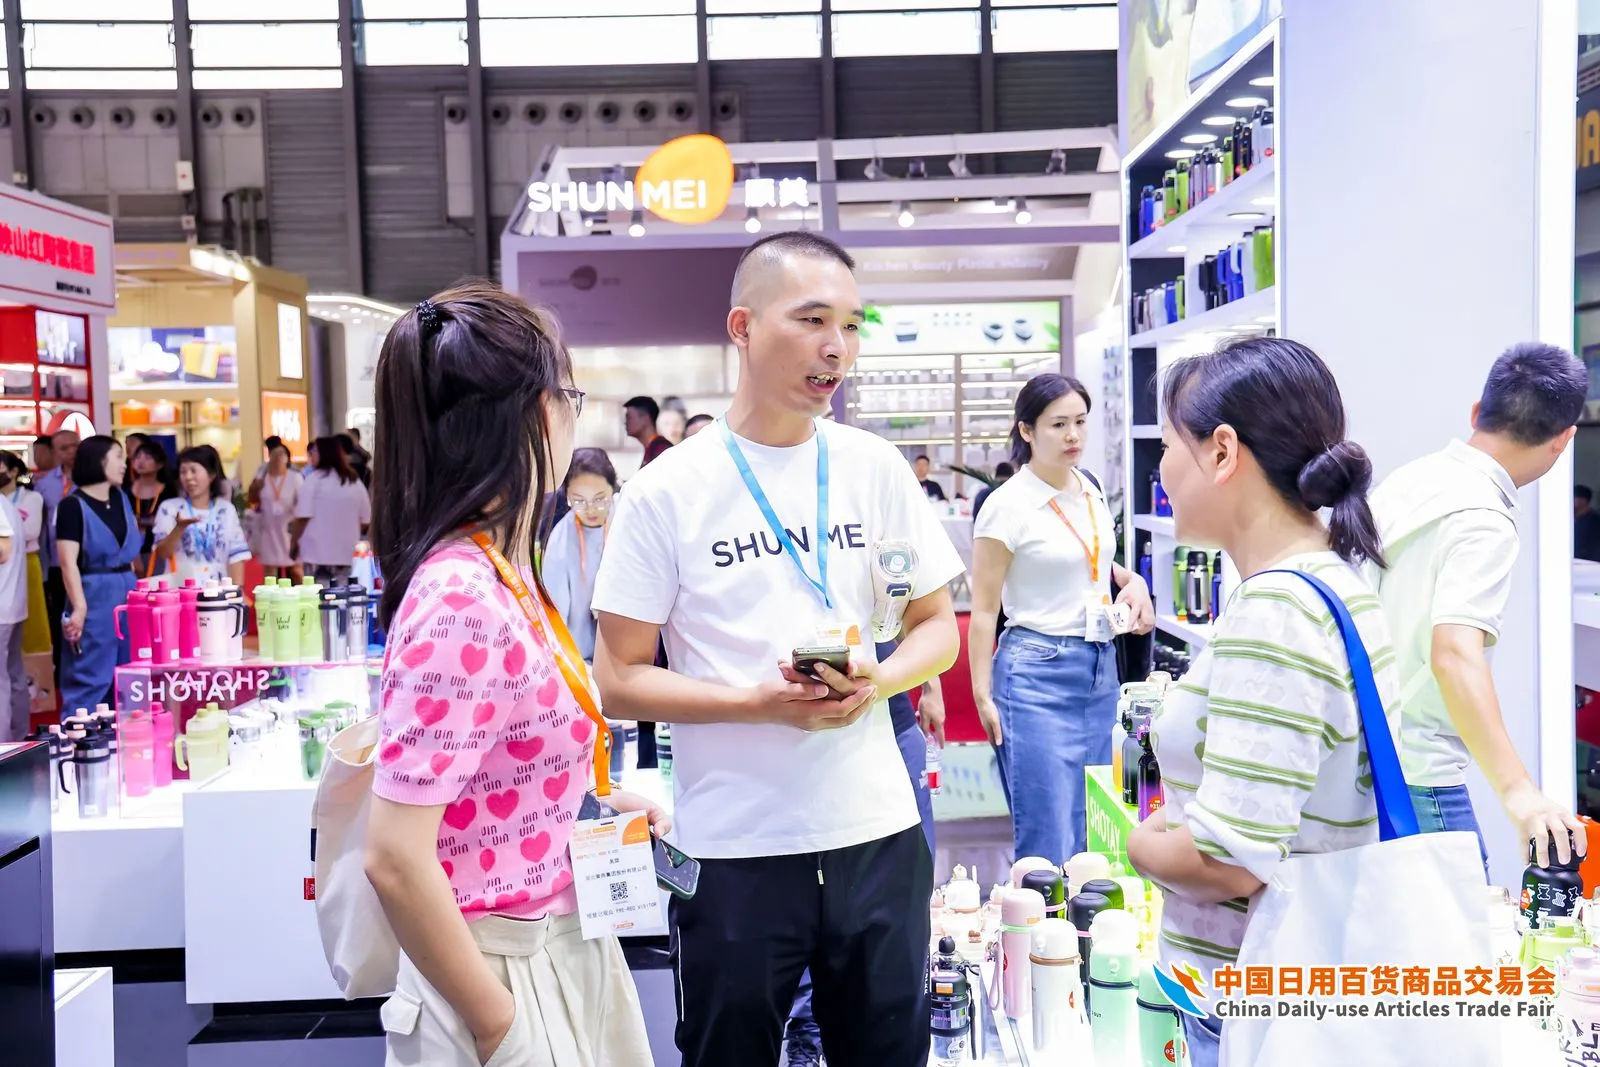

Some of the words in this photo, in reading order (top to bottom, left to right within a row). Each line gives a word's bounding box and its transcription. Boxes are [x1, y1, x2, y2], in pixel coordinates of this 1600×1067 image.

[527, 180, 634, 213] SHUN
[641, 177, 707, 210] MEI
[711, 526, 811, 568] SHUN
[130, 681, 240, 702] SHOTAY
[1089, 796, 1121, 857] SHOTAY
